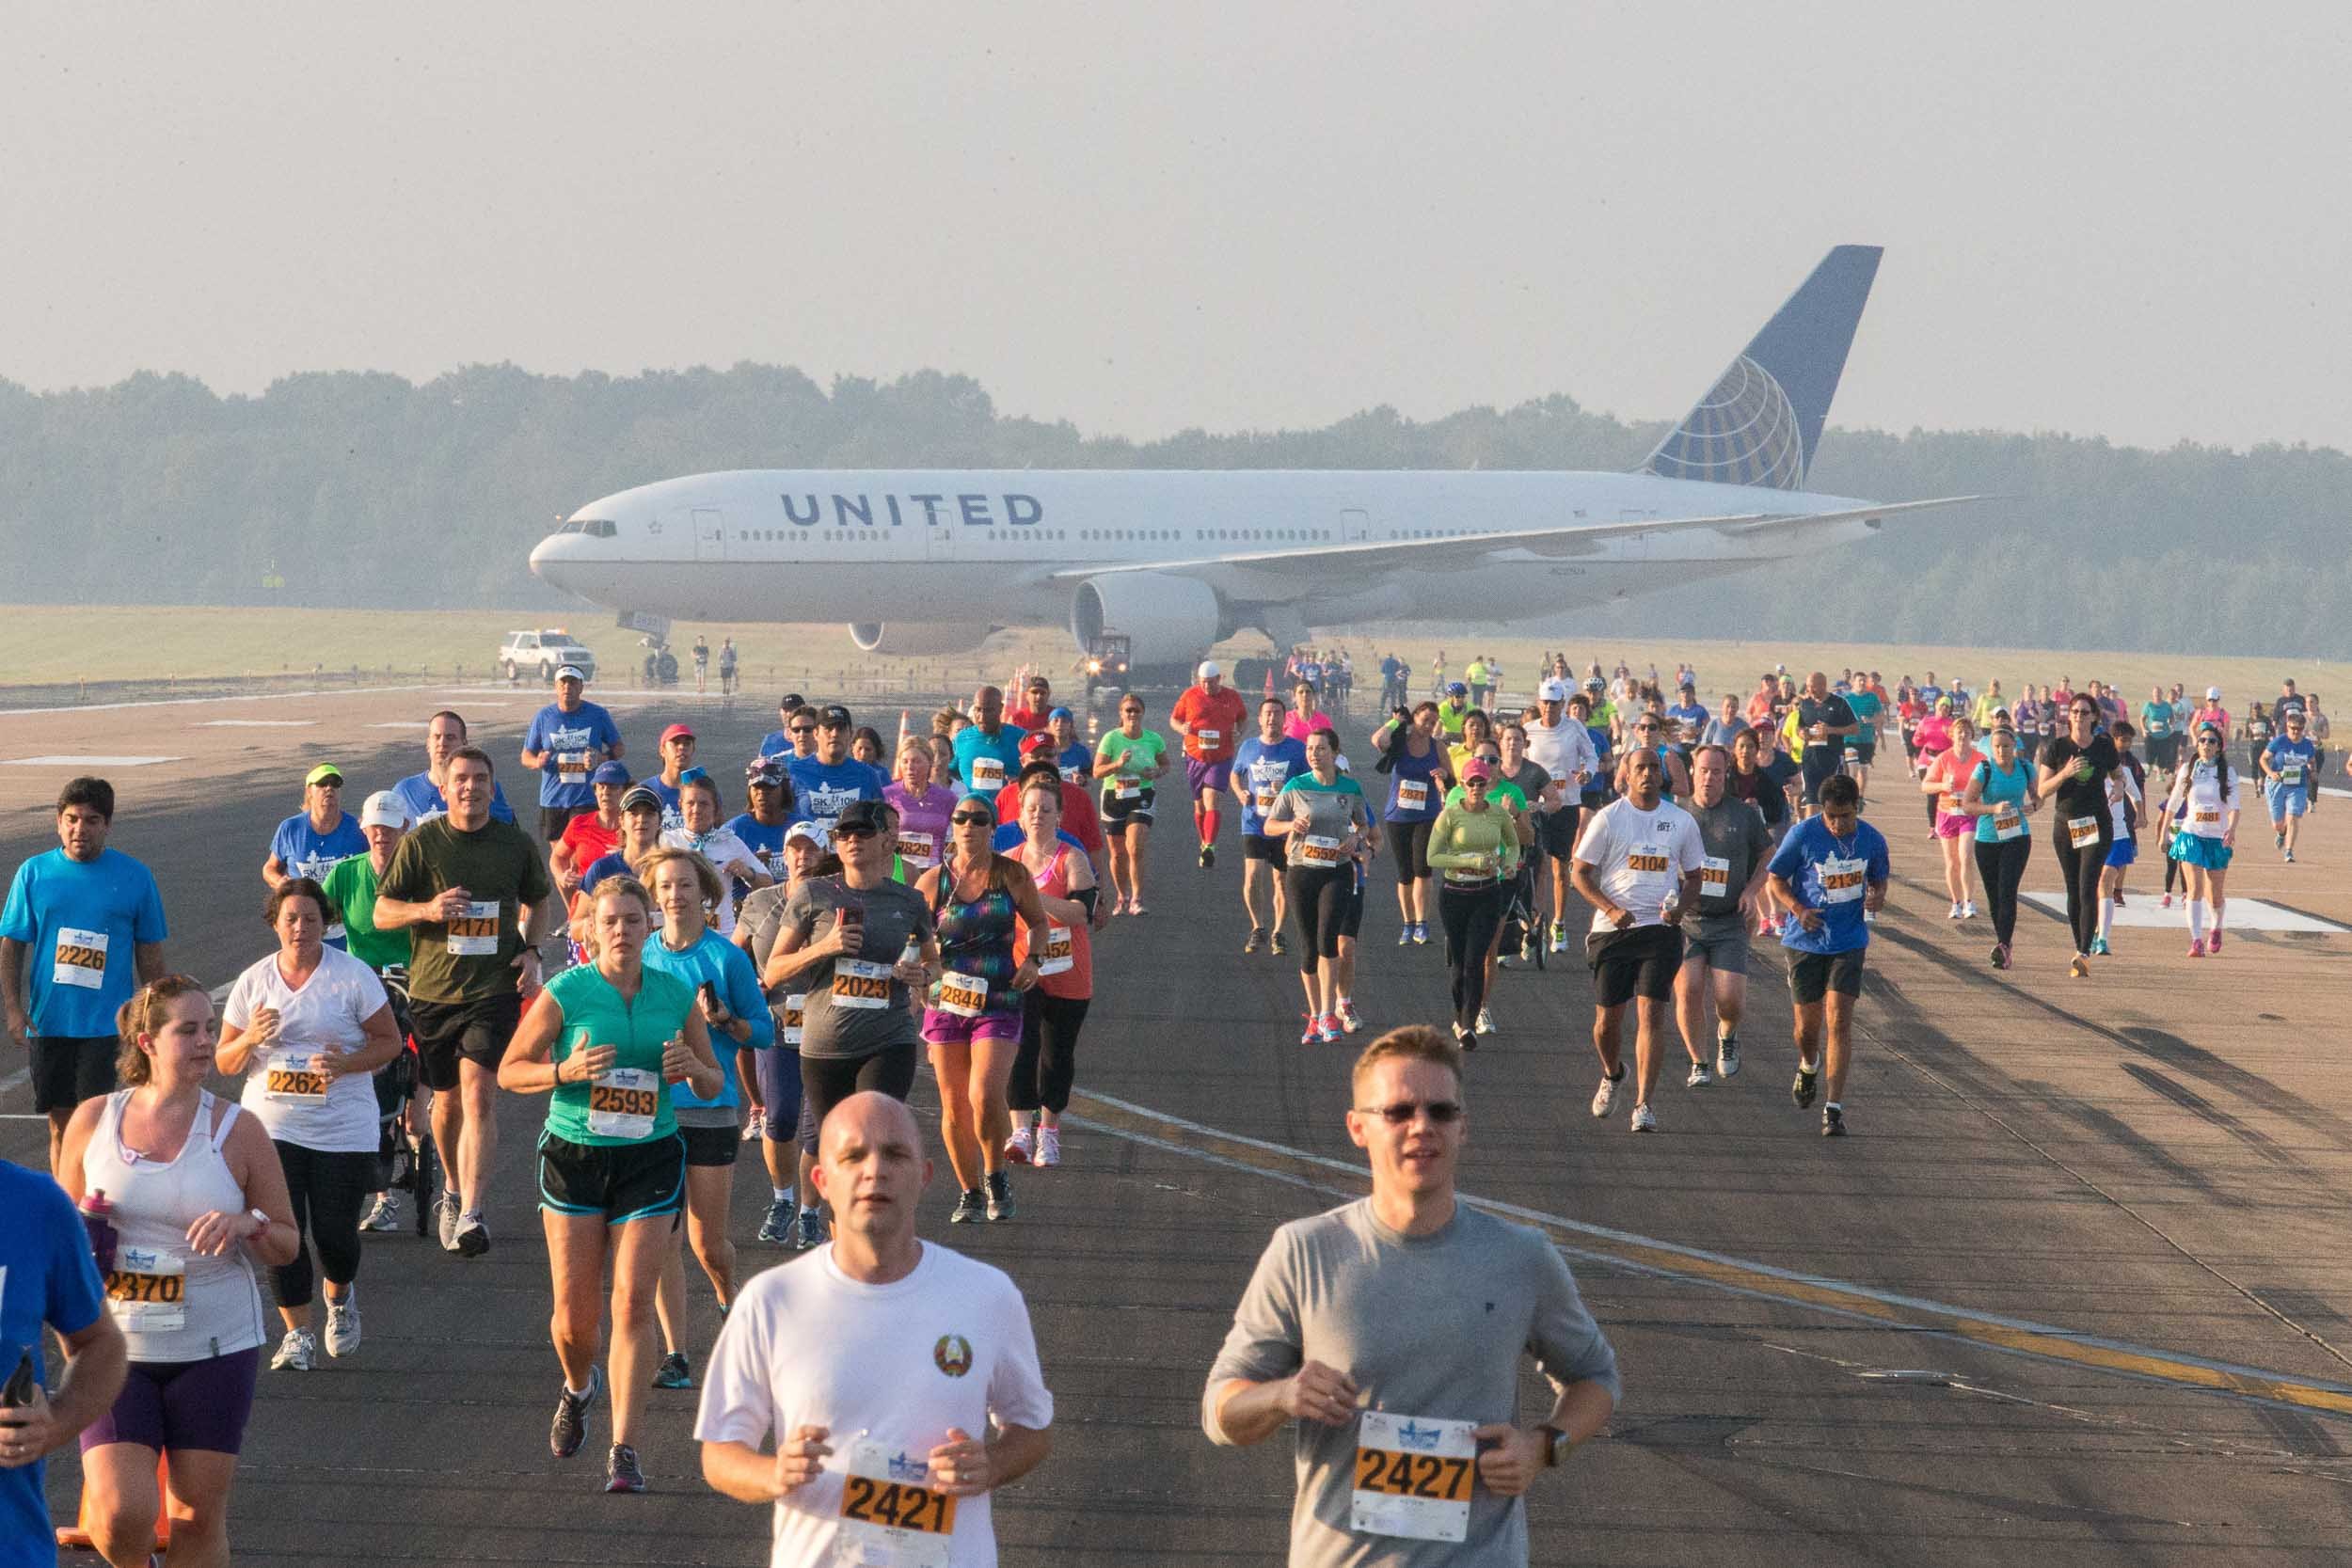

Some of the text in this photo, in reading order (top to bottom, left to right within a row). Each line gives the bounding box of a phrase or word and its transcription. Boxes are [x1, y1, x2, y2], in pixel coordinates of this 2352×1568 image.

[780, 494, 1043, 526] UNITED
[1629, 855, 1666, 871] 2104
[1701, 868, 1724, 883] 611
[451, 918, 494, 937] 2171
[56, 944, 104, 970] 2226
[1043, 941, 1070, 958] 452
[835, 974, 887, 999] 2023
[943, 985, 983, 1009] 2844
[270, 1070, 323, 1094] 2262
[594, 1086, 654, 1116] 2593
[105, 1270, 180, 1302] 2370
[1359, 1449, 1469, 1498] 2427
[845, 1477, 948, 1532] 2421
